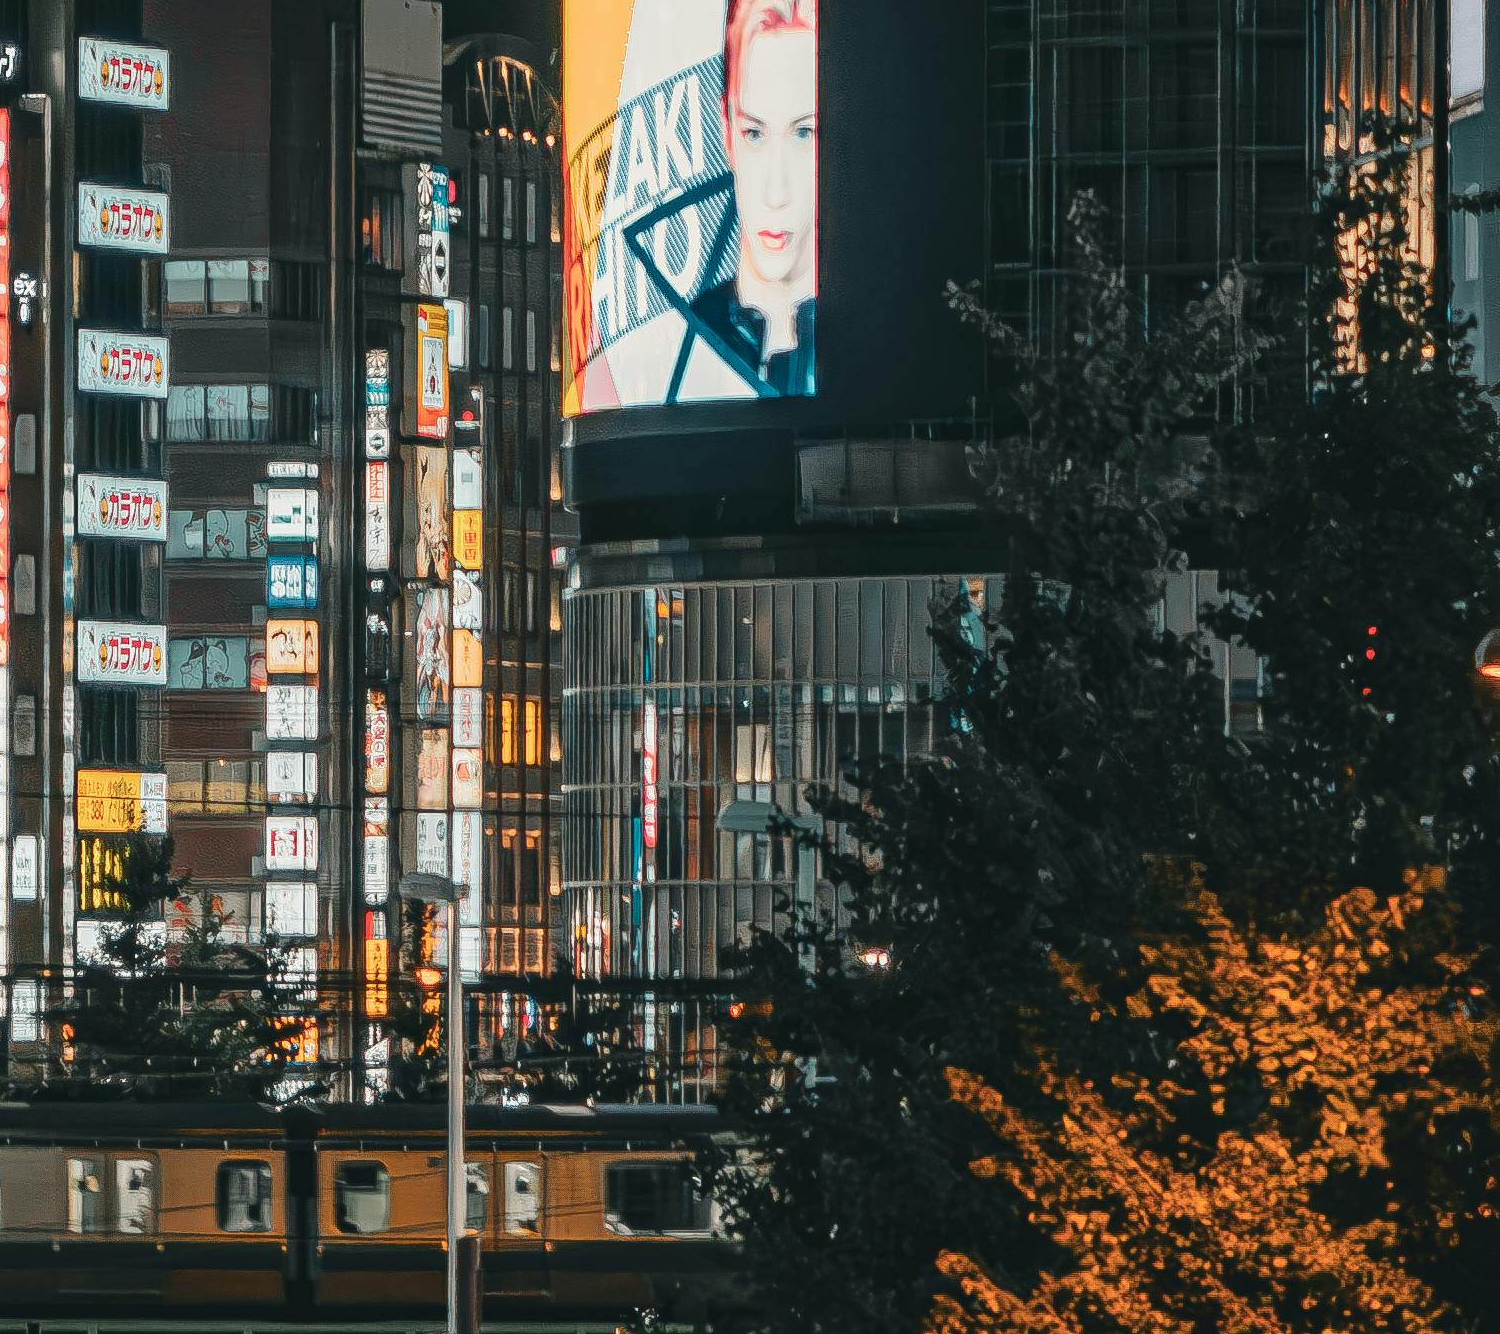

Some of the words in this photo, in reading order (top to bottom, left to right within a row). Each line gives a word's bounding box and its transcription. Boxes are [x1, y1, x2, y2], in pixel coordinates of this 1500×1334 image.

[108, 57, 155, 96] カラオケ
[108, 202, 155, 242] カラオケ
[108, 346, 156, 386] カラオケ
[108, 493, 156, 528] カラオケ
[108, 636, 155, 674] カラオケ
